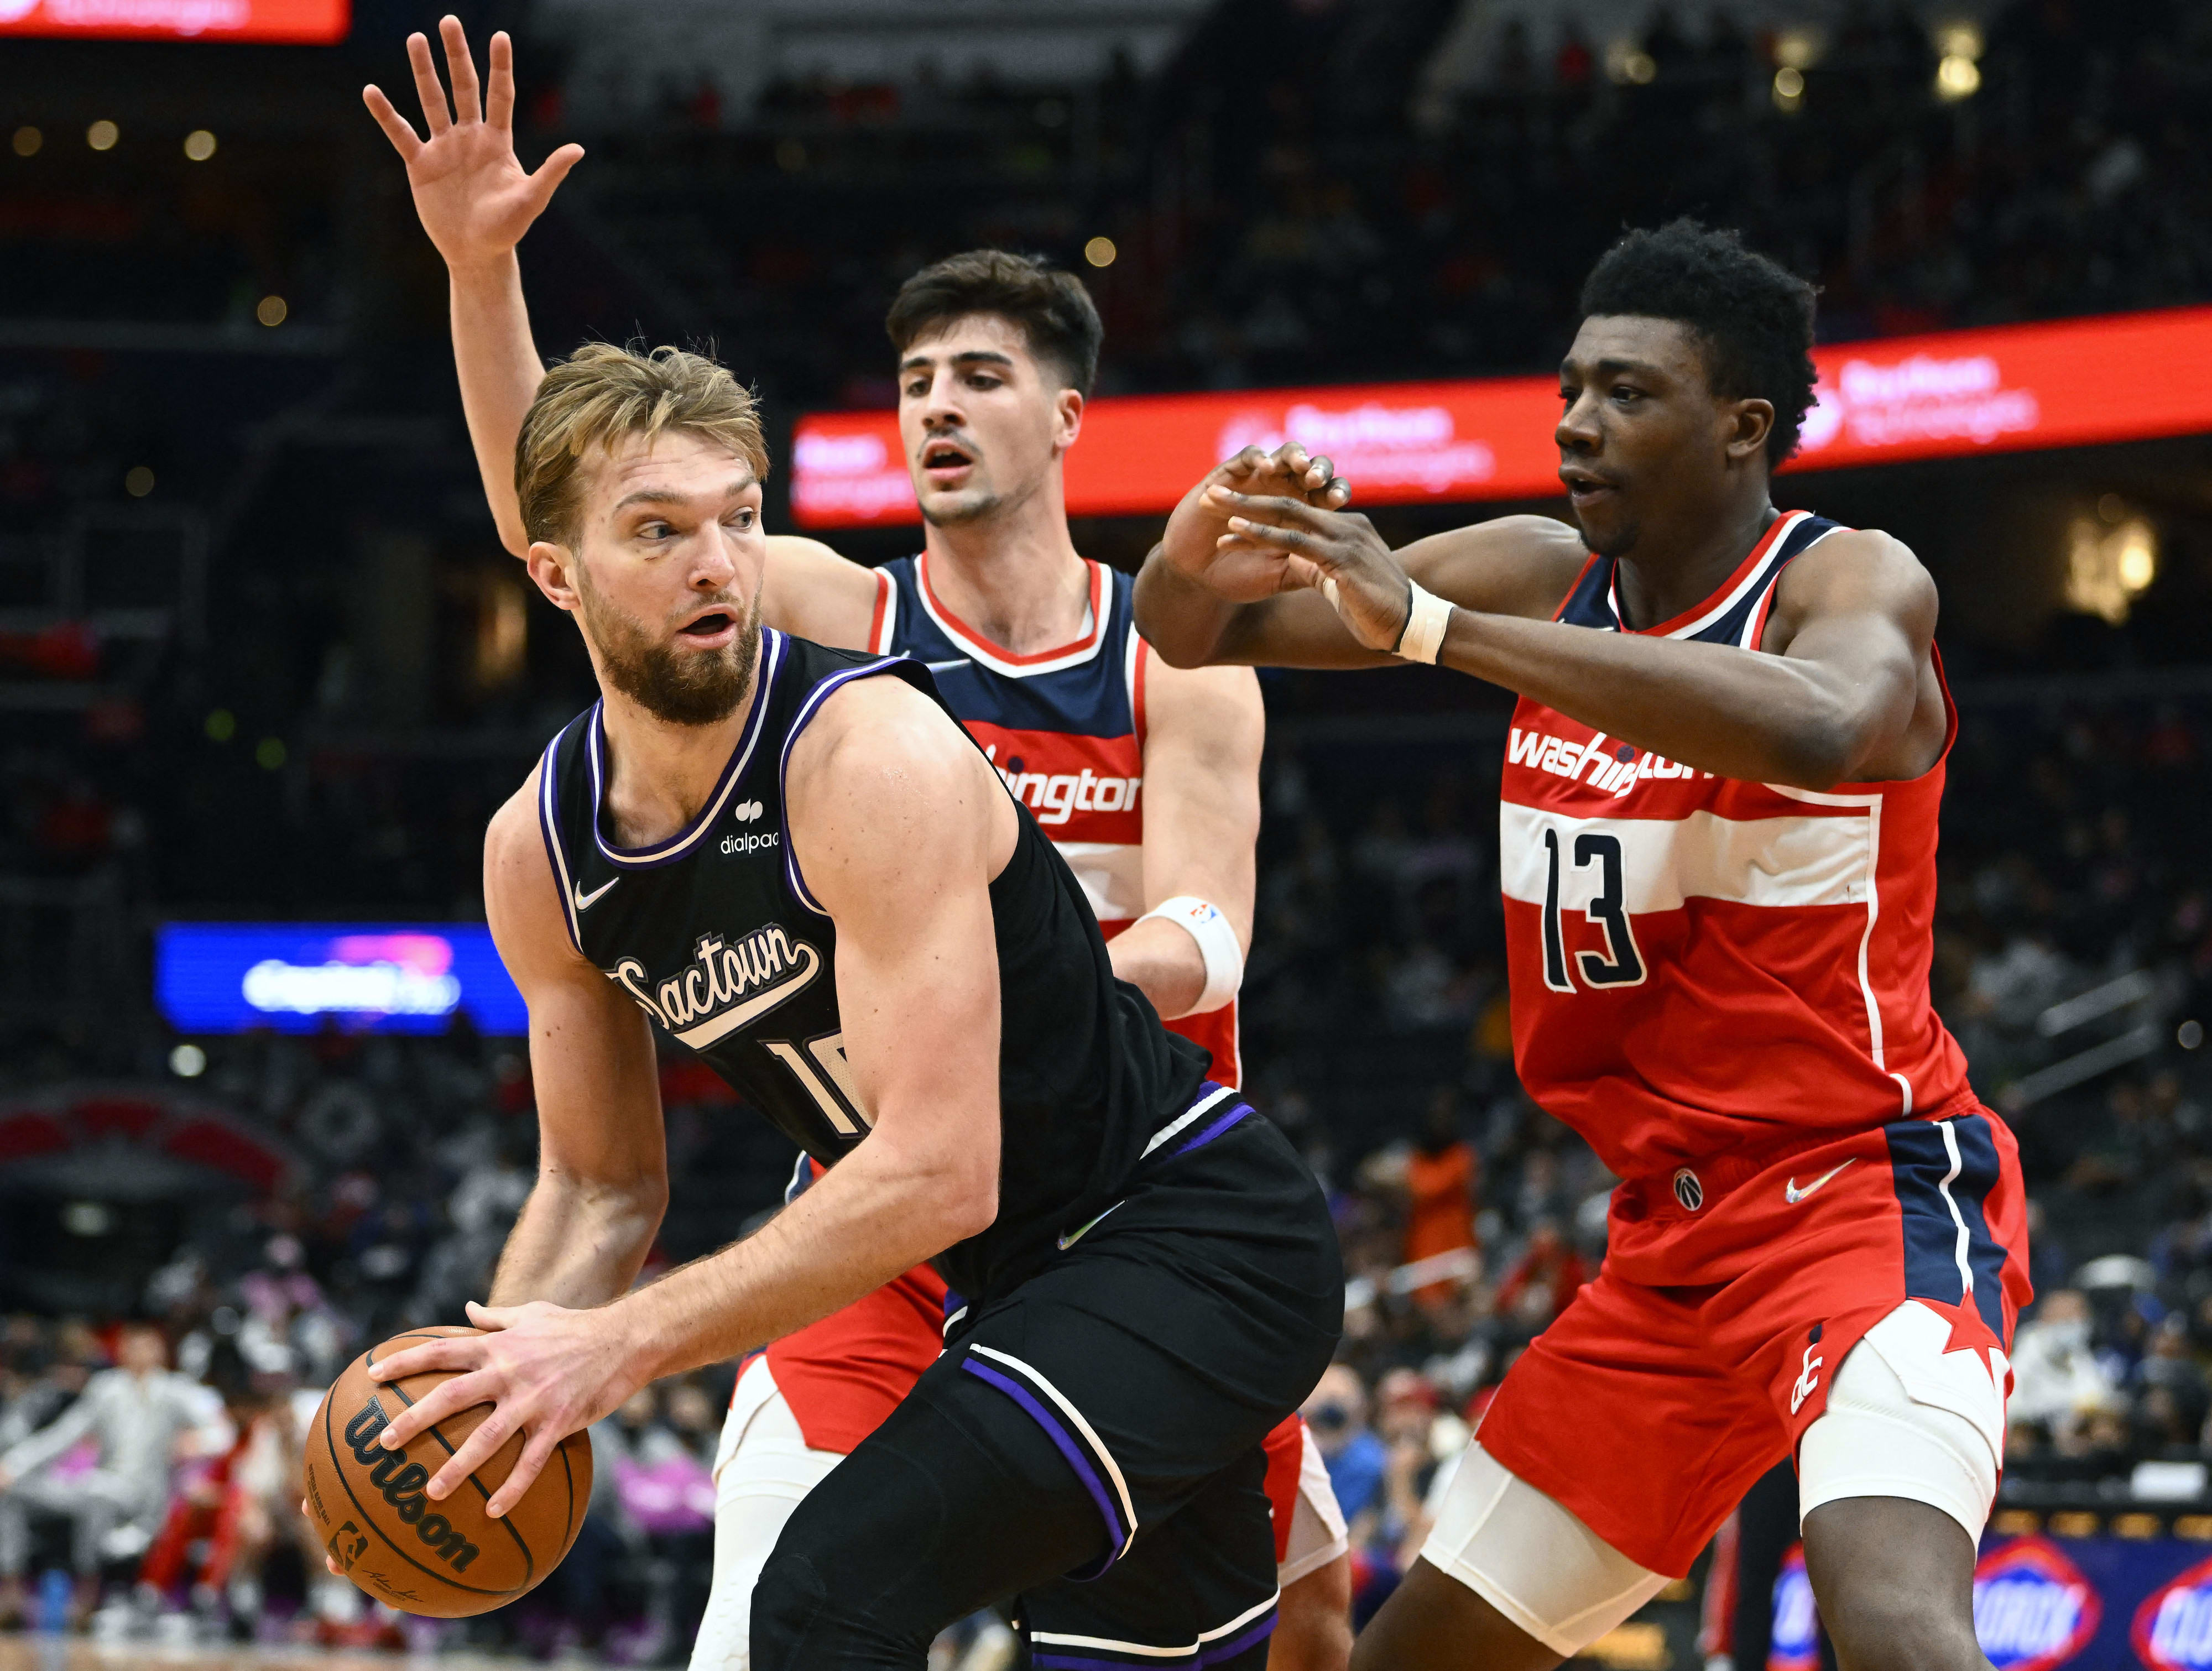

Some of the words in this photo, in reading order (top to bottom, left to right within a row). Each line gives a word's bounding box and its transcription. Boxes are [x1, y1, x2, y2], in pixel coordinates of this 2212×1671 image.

[604, 923, 822, 1038] Sactown
[1541, 824, 1647, 993] 13
[345, 1395, 480, 1573] Wilson
